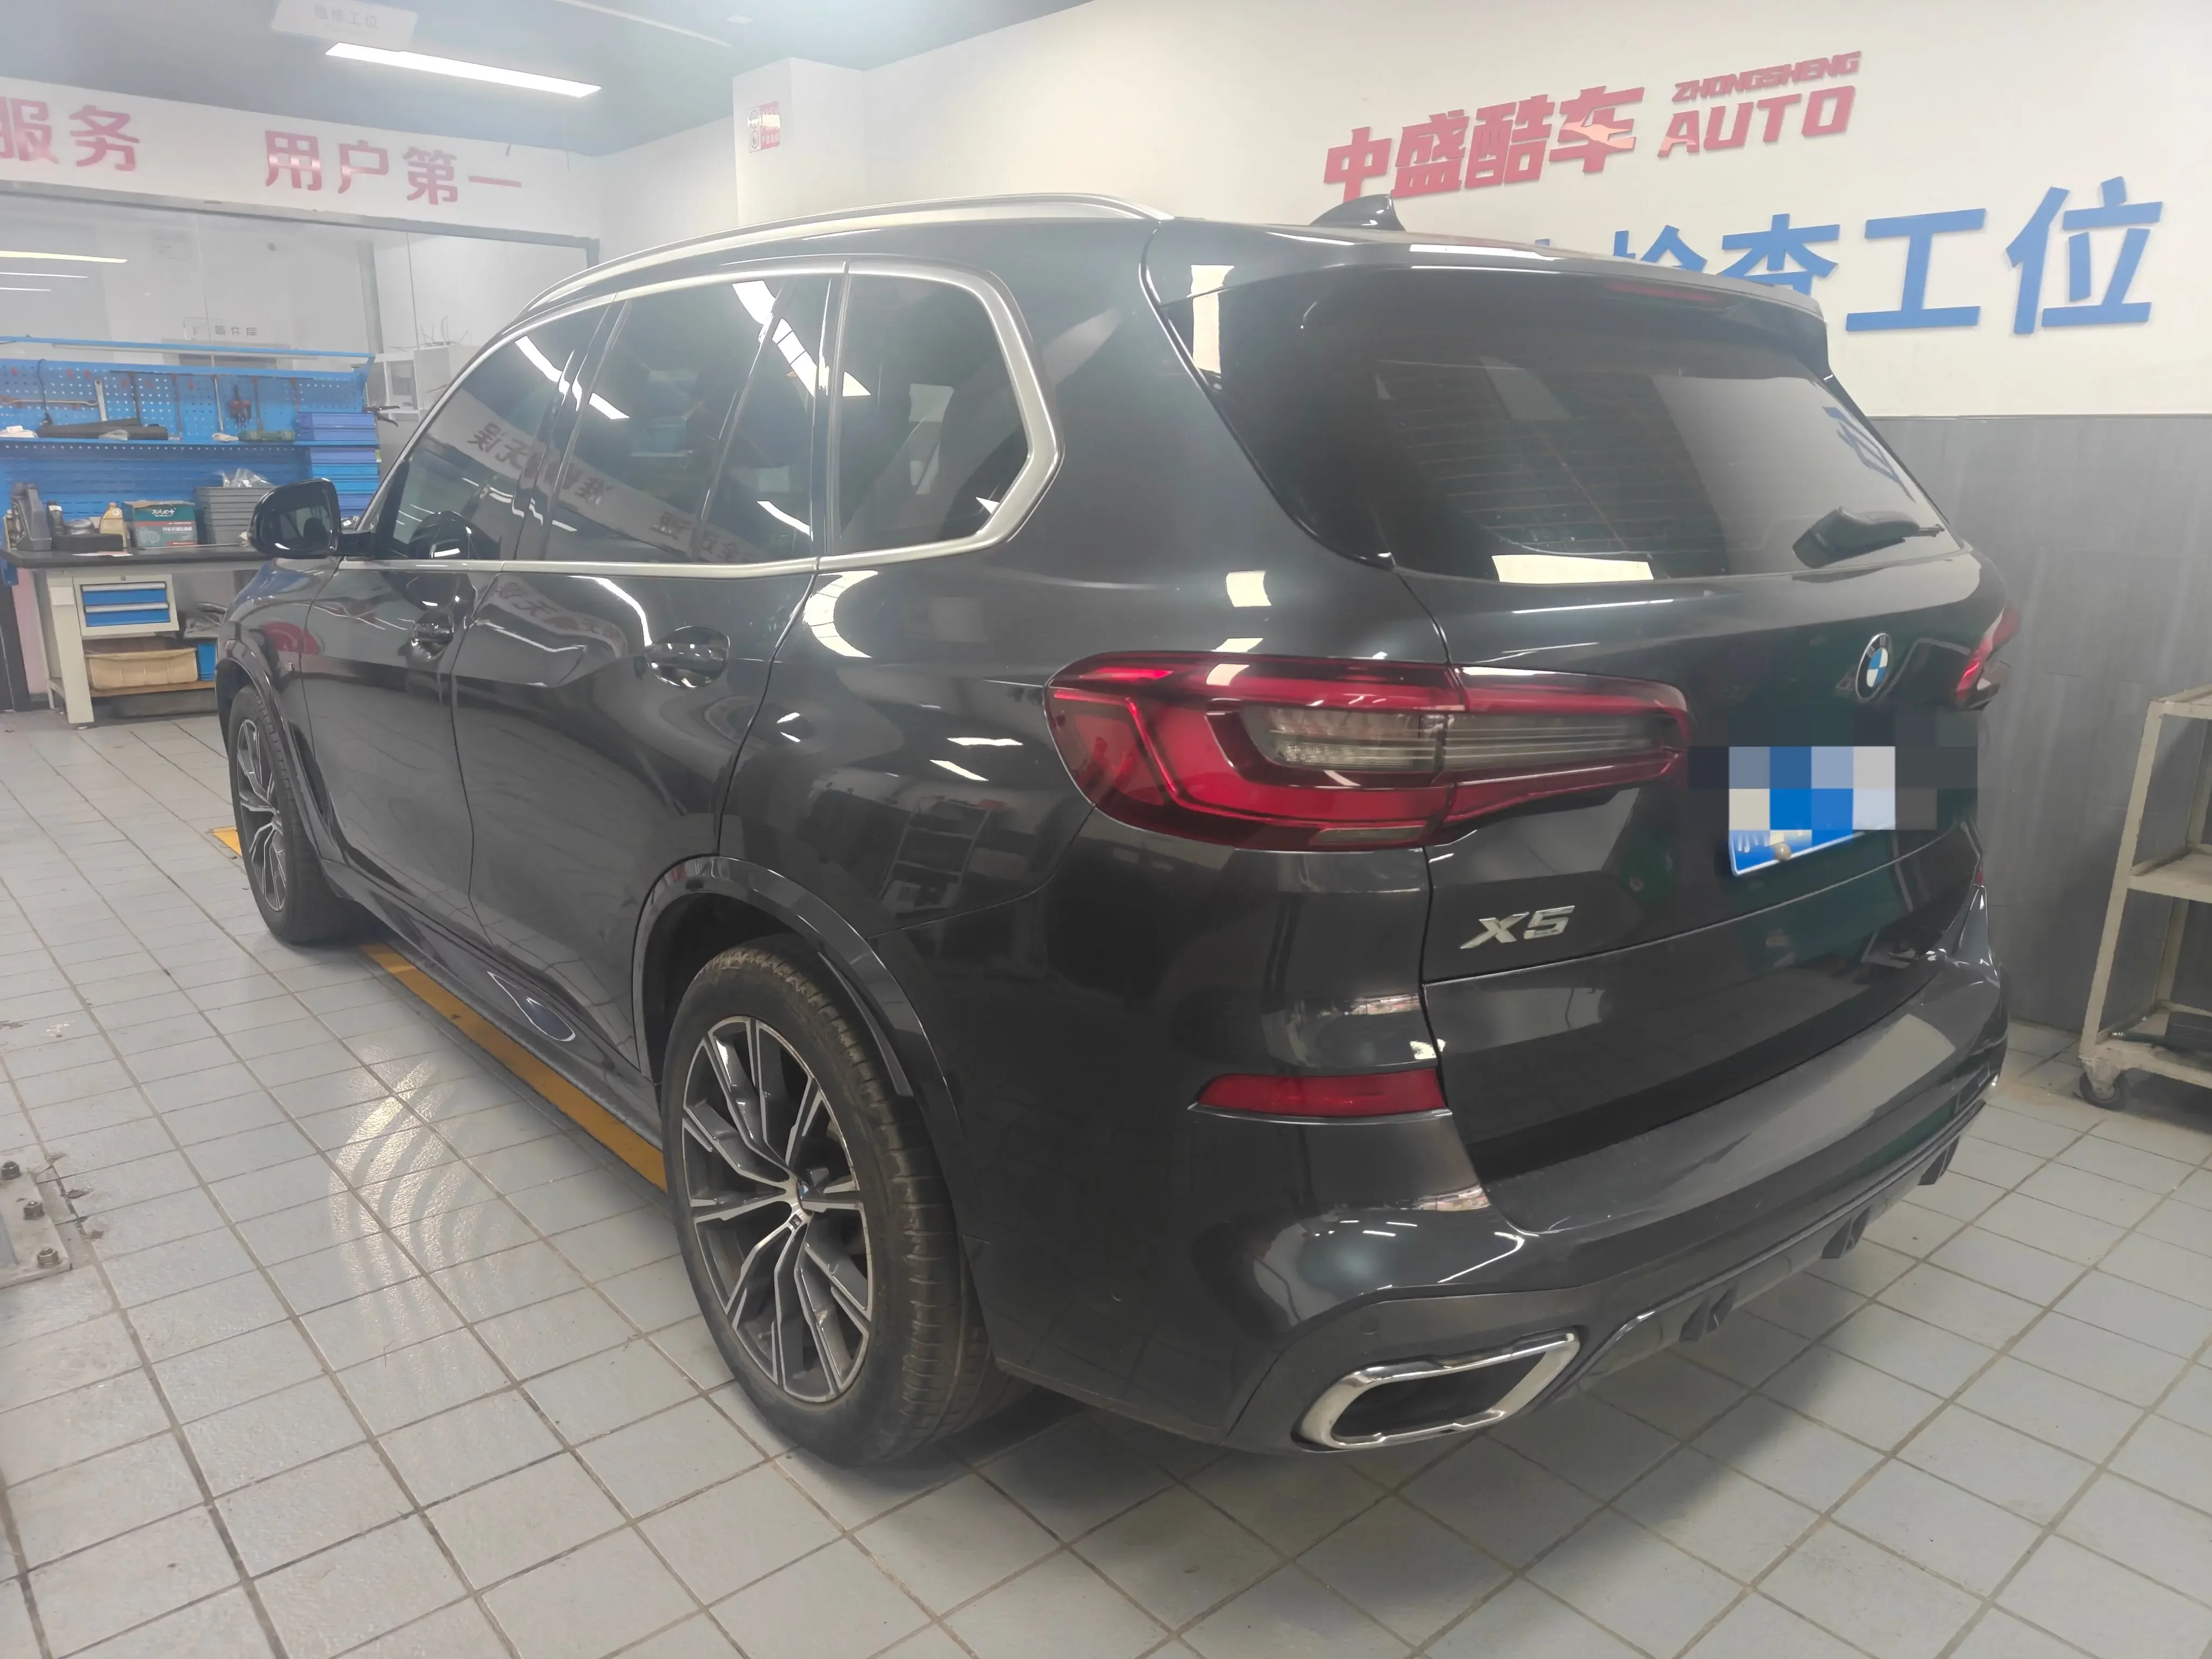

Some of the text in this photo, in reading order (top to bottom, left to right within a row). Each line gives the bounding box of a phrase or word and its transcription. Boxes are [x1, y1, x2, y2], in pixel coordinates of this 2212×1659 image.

[1671, 51, 1862, 102] ZHONGSHENG
[0, 96, 522, 205] 服务 用户第一
[1324, 85, 1645, 203] 中盛酷车
[1657, 85, 1856, 158] AUTO
[1459, 905, 1575, 949] X5
